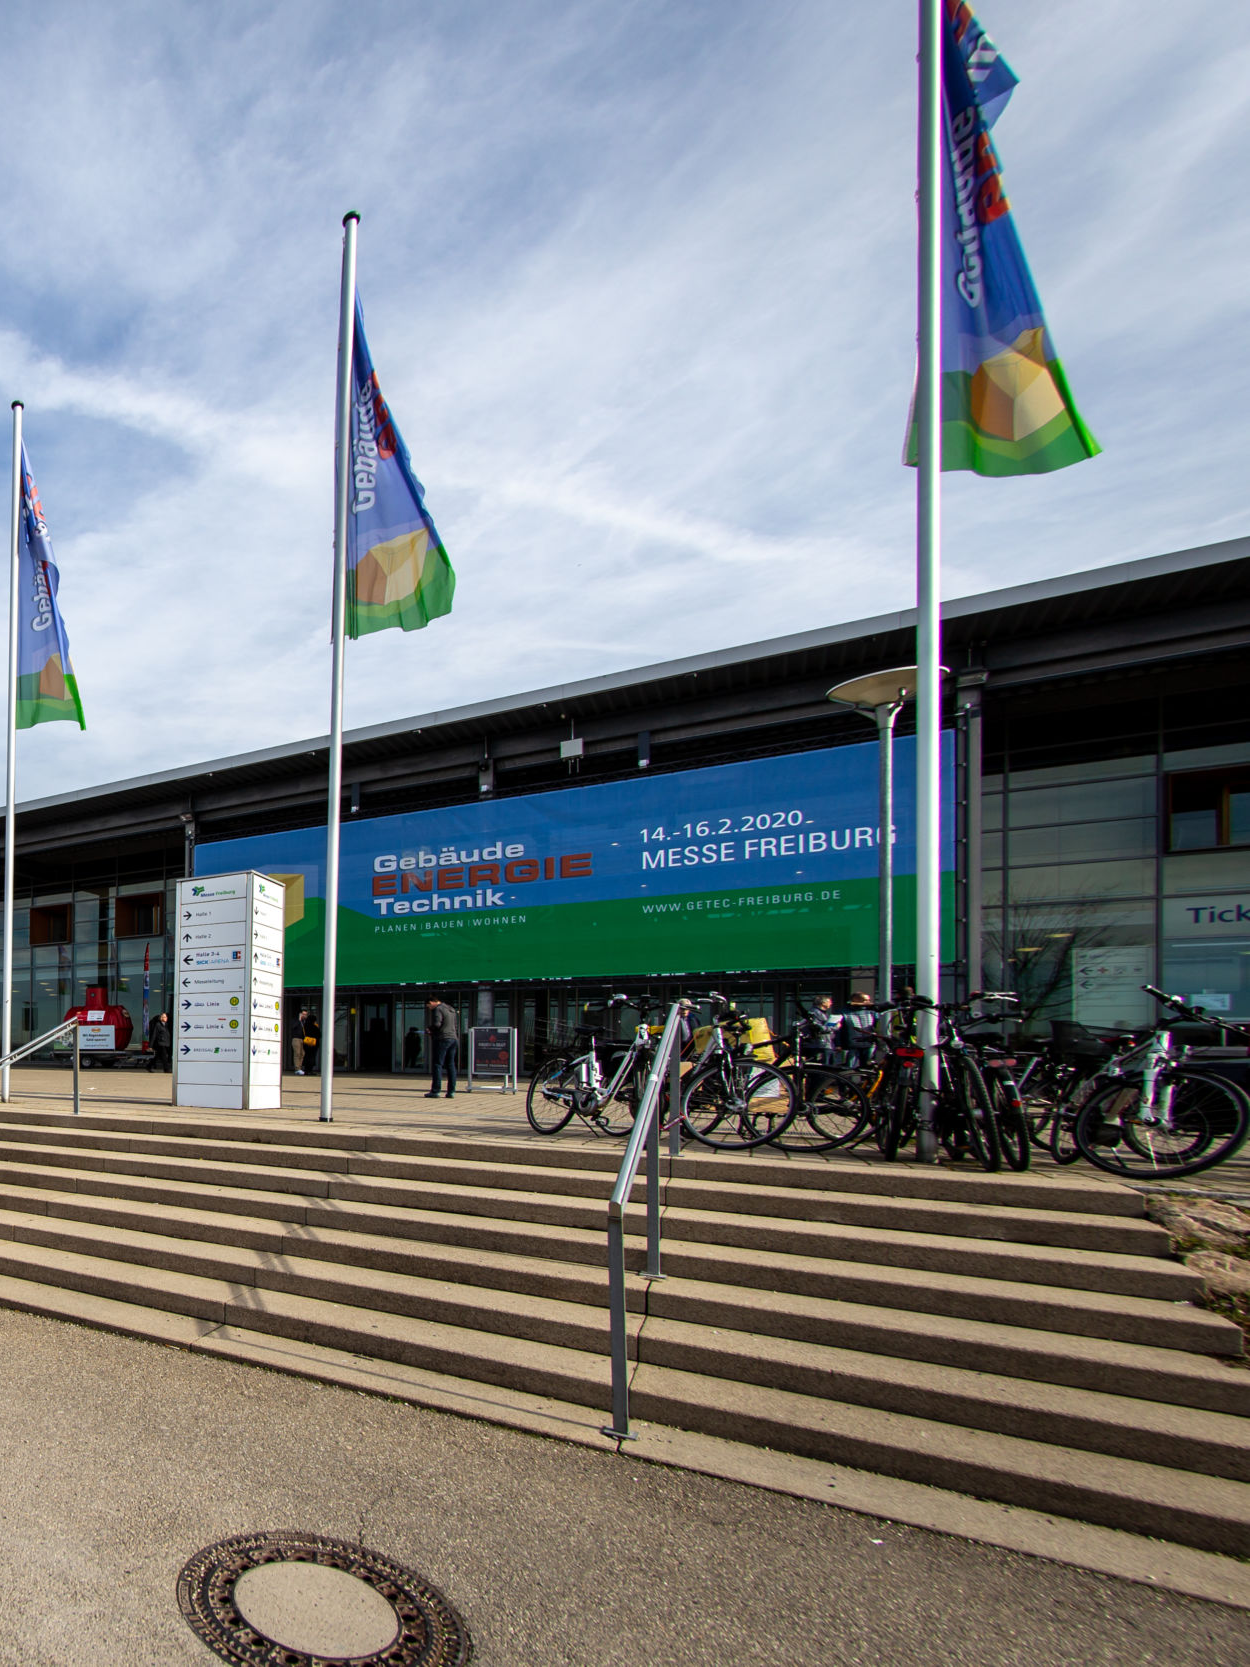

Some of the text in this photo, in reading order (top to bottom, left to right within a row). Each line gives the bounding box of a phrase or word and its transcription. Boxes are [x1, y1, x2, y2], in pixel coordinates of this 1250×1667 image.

[640, 809, 803, 844] 14.-16.2.2020
[373, 841, 525, 874] Gebäude
[642, 841, 736, 870] MESSE
[371, 852, 594, 896] ENERGIE
[373, 888, 505, 916] Technik
[642, 889, 842, 914] WWW.GETEC-FREIBURG.DE
[1185, 904, 1250, 924] Tick
[374, 914, 527, 934] PLANEN BAUEN WOHNEN
